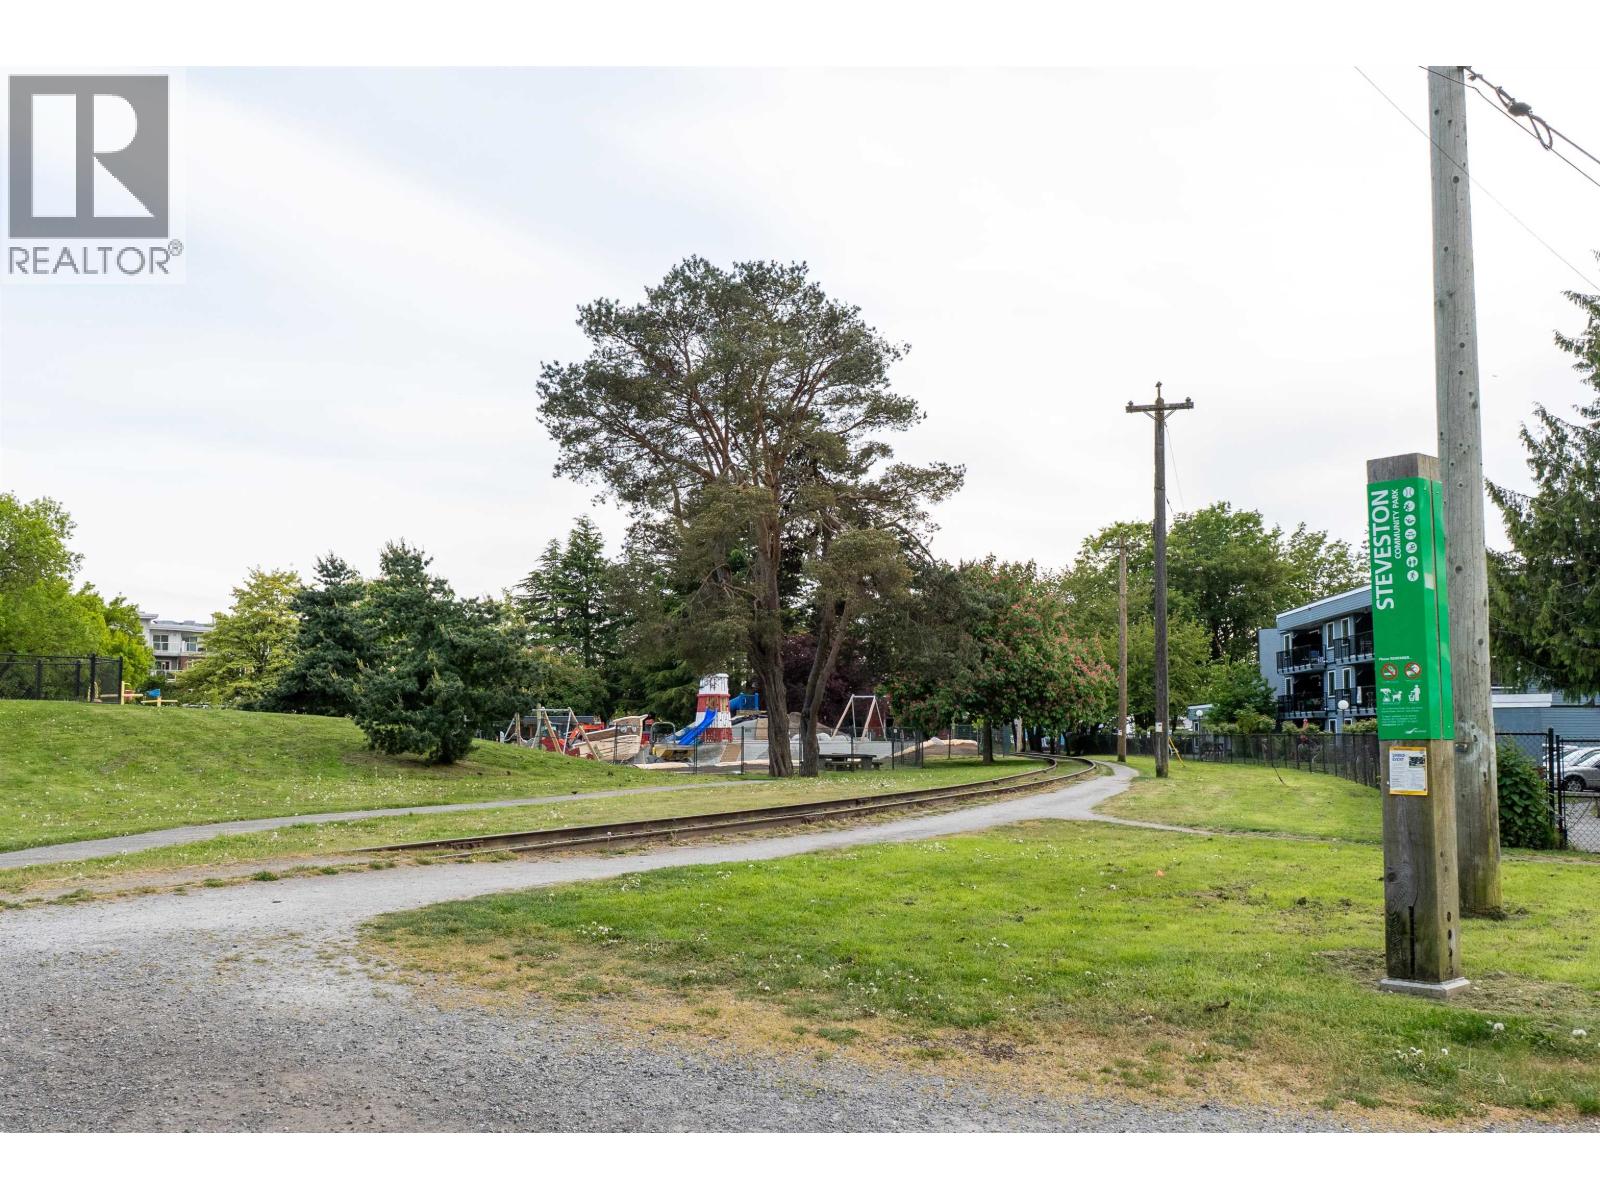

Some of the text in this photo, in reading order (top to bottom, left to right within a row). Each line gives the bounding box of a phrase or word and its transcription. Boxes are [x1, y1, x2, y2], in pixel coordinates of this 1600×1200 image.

[1370, 489, 1395, 611] STEVESTON
[1391, 488, 1402, 560] COMMUNITY PARK
